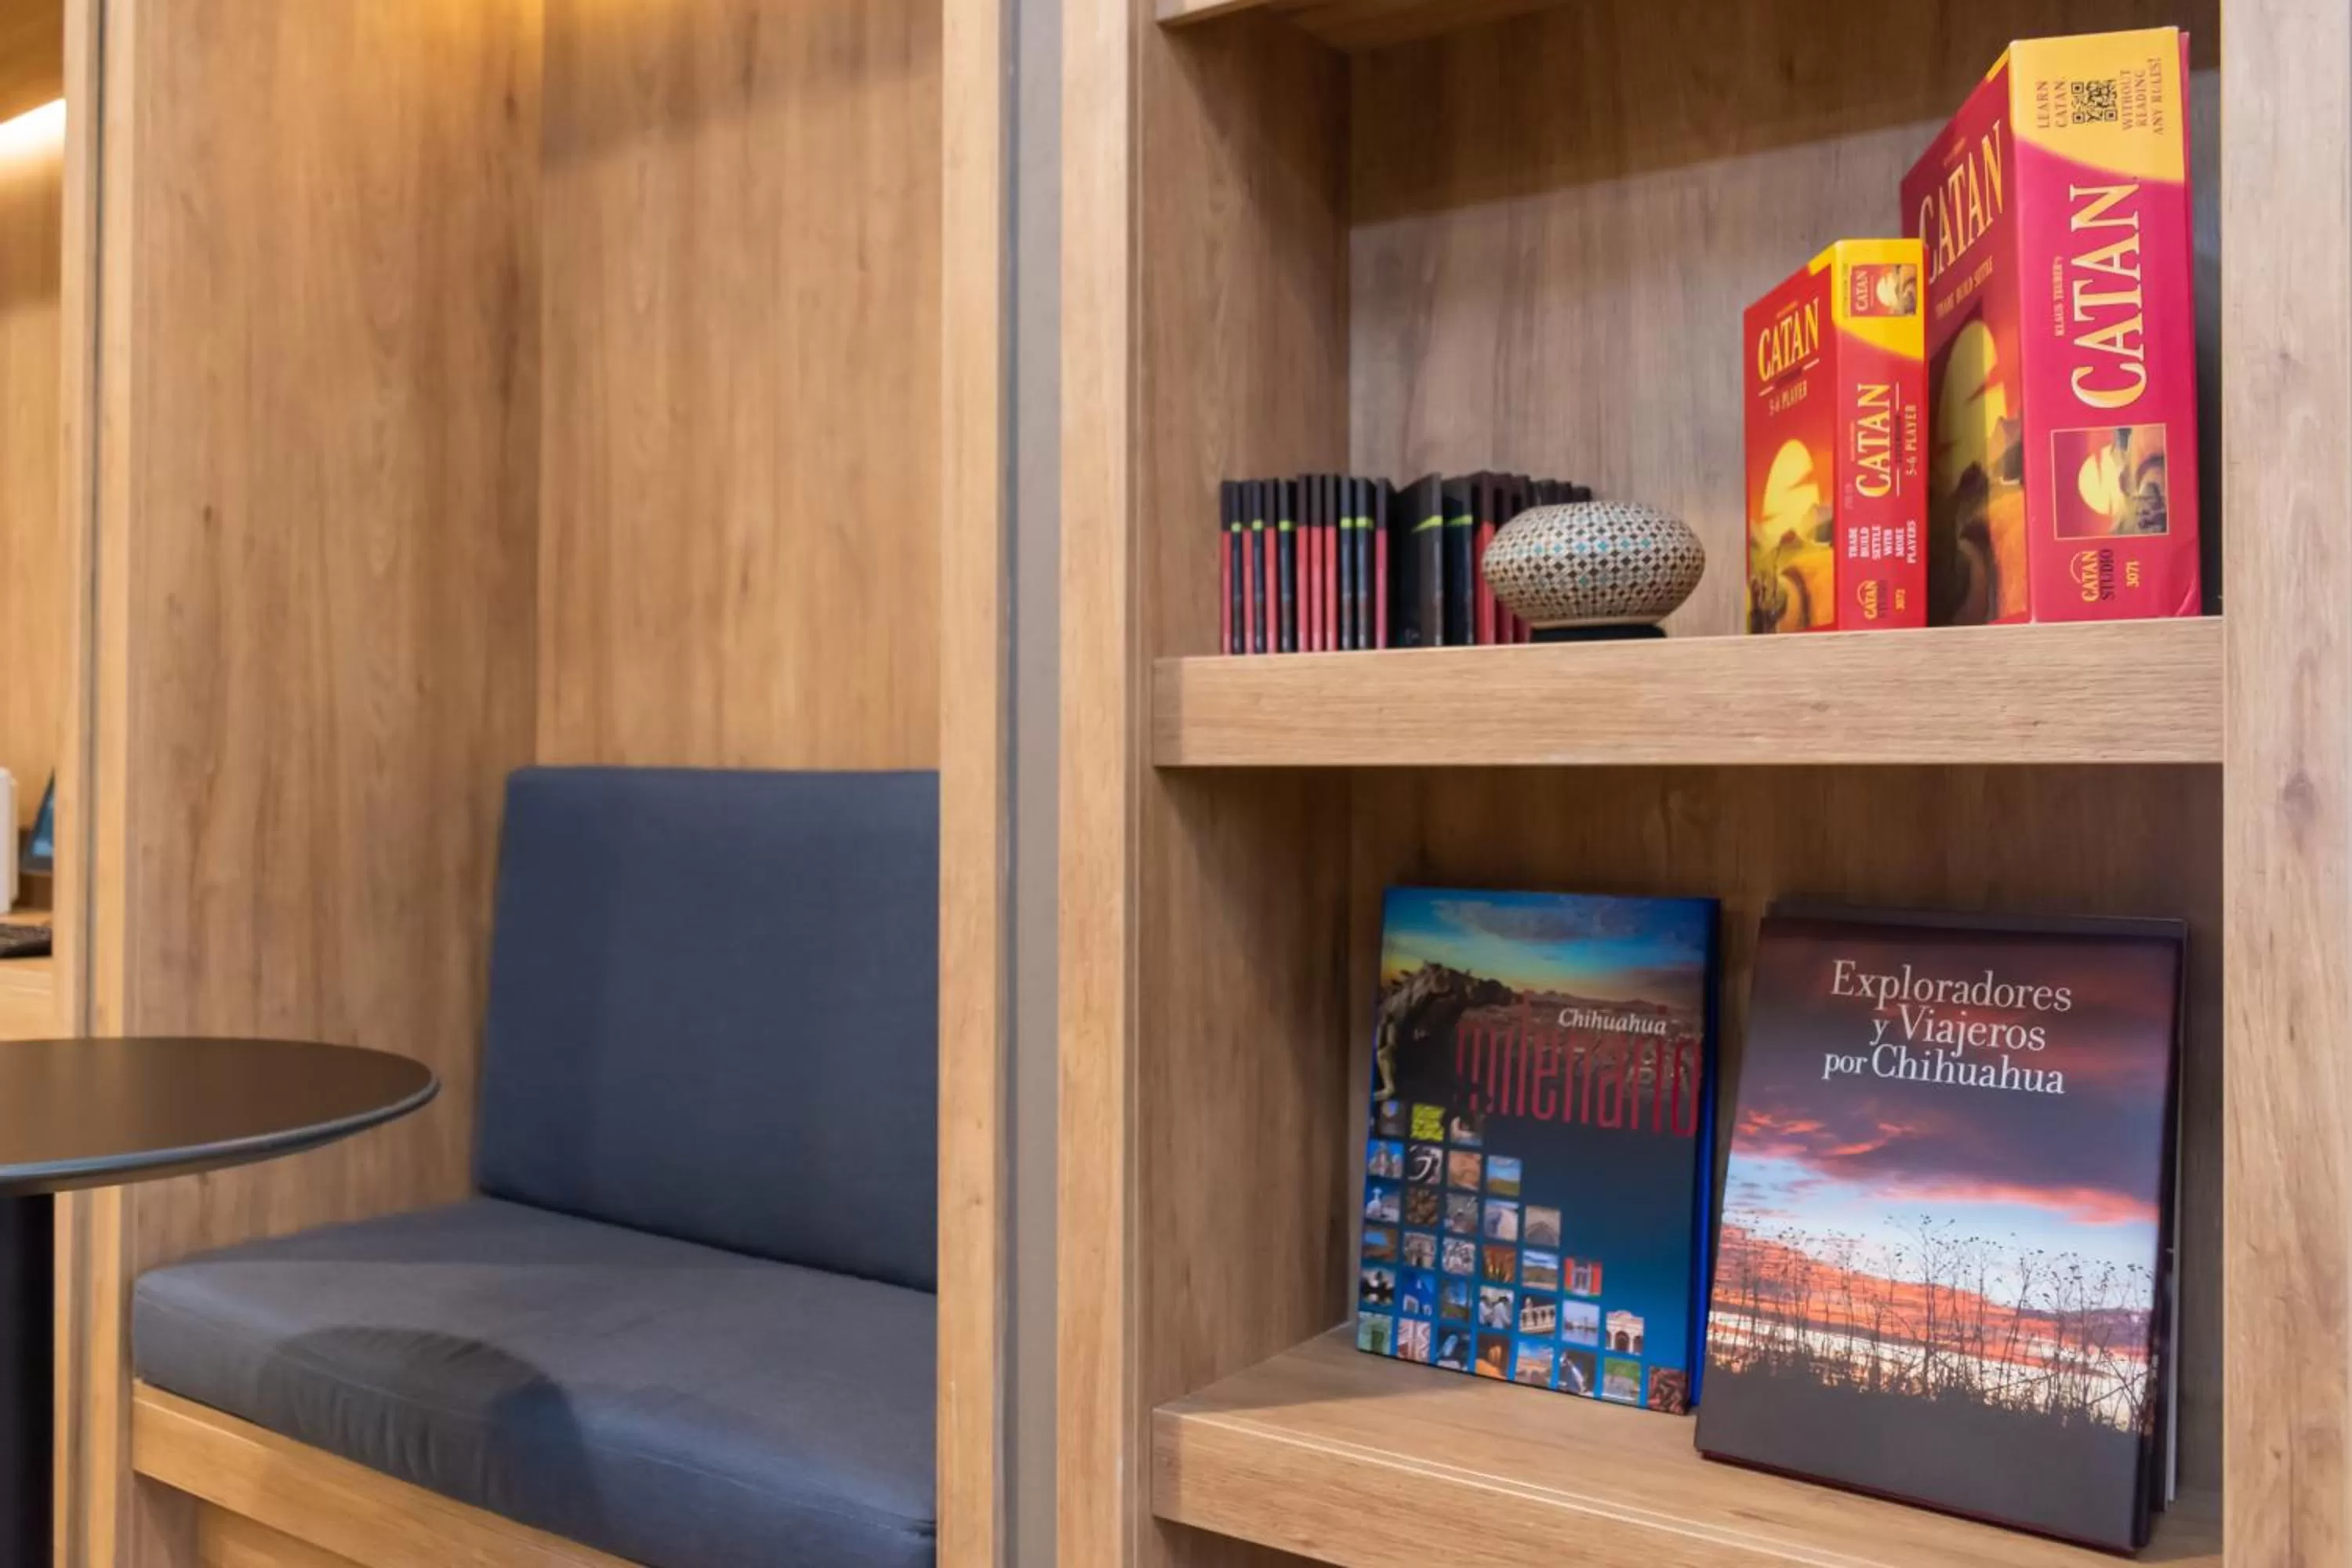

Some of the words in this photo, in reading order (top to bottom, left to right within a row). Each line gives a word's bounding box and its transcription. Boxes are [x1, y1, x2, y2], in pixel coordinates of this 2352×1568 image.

[2120, 69, 2132, 131] WITHOUT
[2135, 68, 2147, 127] READING
[2147, 57, 2163, 103] RULES!
[2037, 79, 2050, 129] LEARN
[2151, 108, 2164, 136] ANY
[1918, 119, 2003, 286] CATAN
[1854, 270, 1869, 311] CATAN
[2069, 183, 2148, 409] CATAN
[1758, 296, 1820, 383] CATAN
[2053, 303, 2064, 337] KLAUS
[1781, 379, 1808, 411] PLAYER
[1855, 383, 1891, 497] CATAN
[1904, 404, 1917, 451] PLAYER
[1905, 456, 1918, 477] 5-6
[1848, 527, 1857, 559] TRADE
[1860, 526, 1869, 557] BUILD
[1871, 525, 1881, 560] SETTLE
[1906, 520, 1917, 564] PLAYERS
[2082, 550, 2099, 602] CATAN
[2100, 549, 2115, 601] STUDIO
[1863, 580, 1878, 620] CATAN
[1830, 959, 2072, 1012] Exploradores
[1558, 1007, 1667, 1035] Chihuahua
[1869, 1018, 1890, 1046] y
[1897, 1004, 2046, 1057] Viajeros
[1821, 1052, 1867, 1080] por
[1871, 1044, 2067, 1094] Chihuahua
